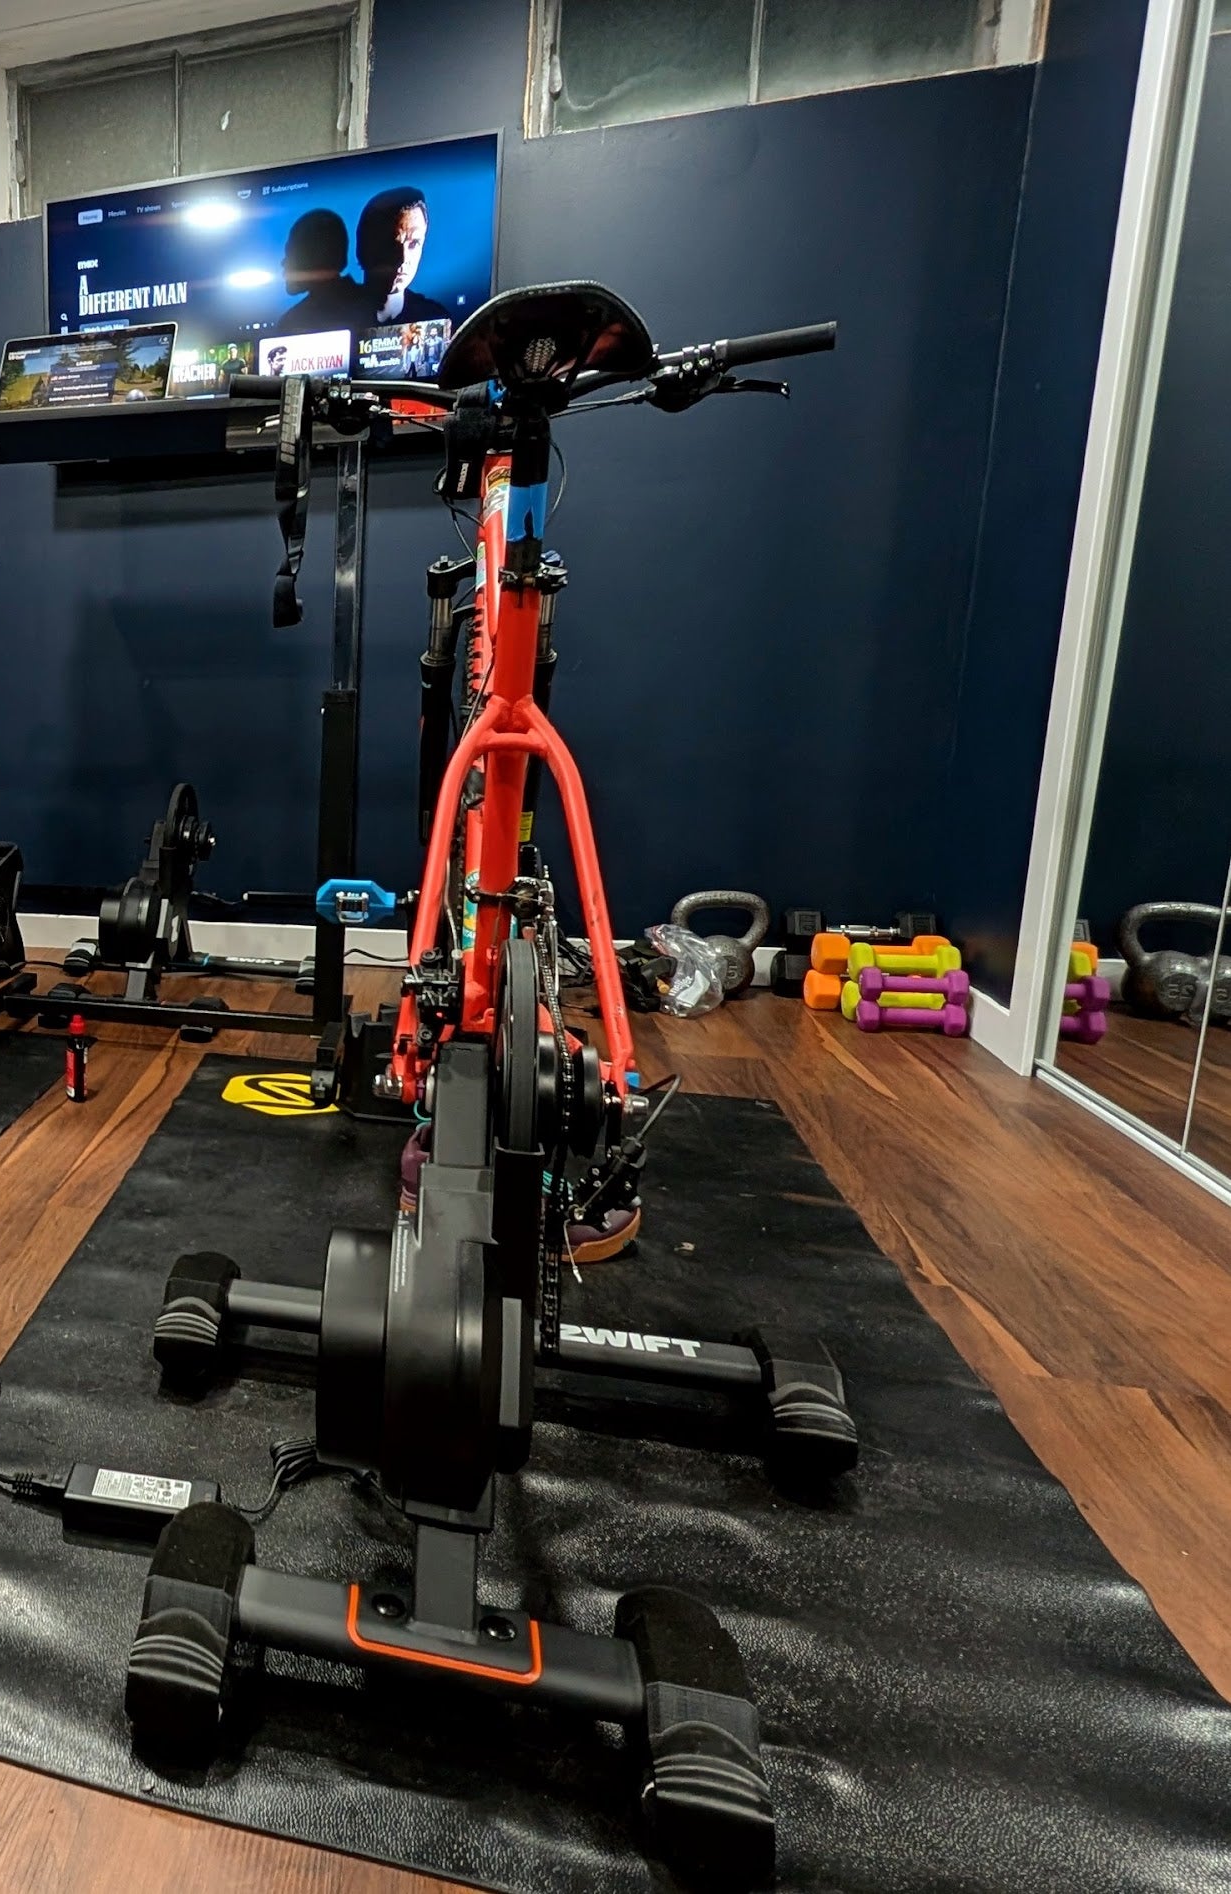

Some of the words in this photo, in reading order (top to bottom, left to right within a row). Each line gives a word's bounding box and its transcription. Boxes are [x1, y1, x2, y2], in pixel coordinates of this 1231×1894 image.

[271, 182, 309, 193] Subscriptions
[77, 259, 99, 270] max
[79, 275, 89, 295] A
[79, 286, 150, 316] DIFFERENT
[152, 281, 187, 307] MAN
[358, 340, 372, 354] 16
[372, 336, 402, 347] EMMY
[290, 359, 314, 372] JACK
[317, 354, 343, 370] RYAN
[172, 363, 216, 383] REACHER
[559, 1323, 701, 1358] ZWIFT
